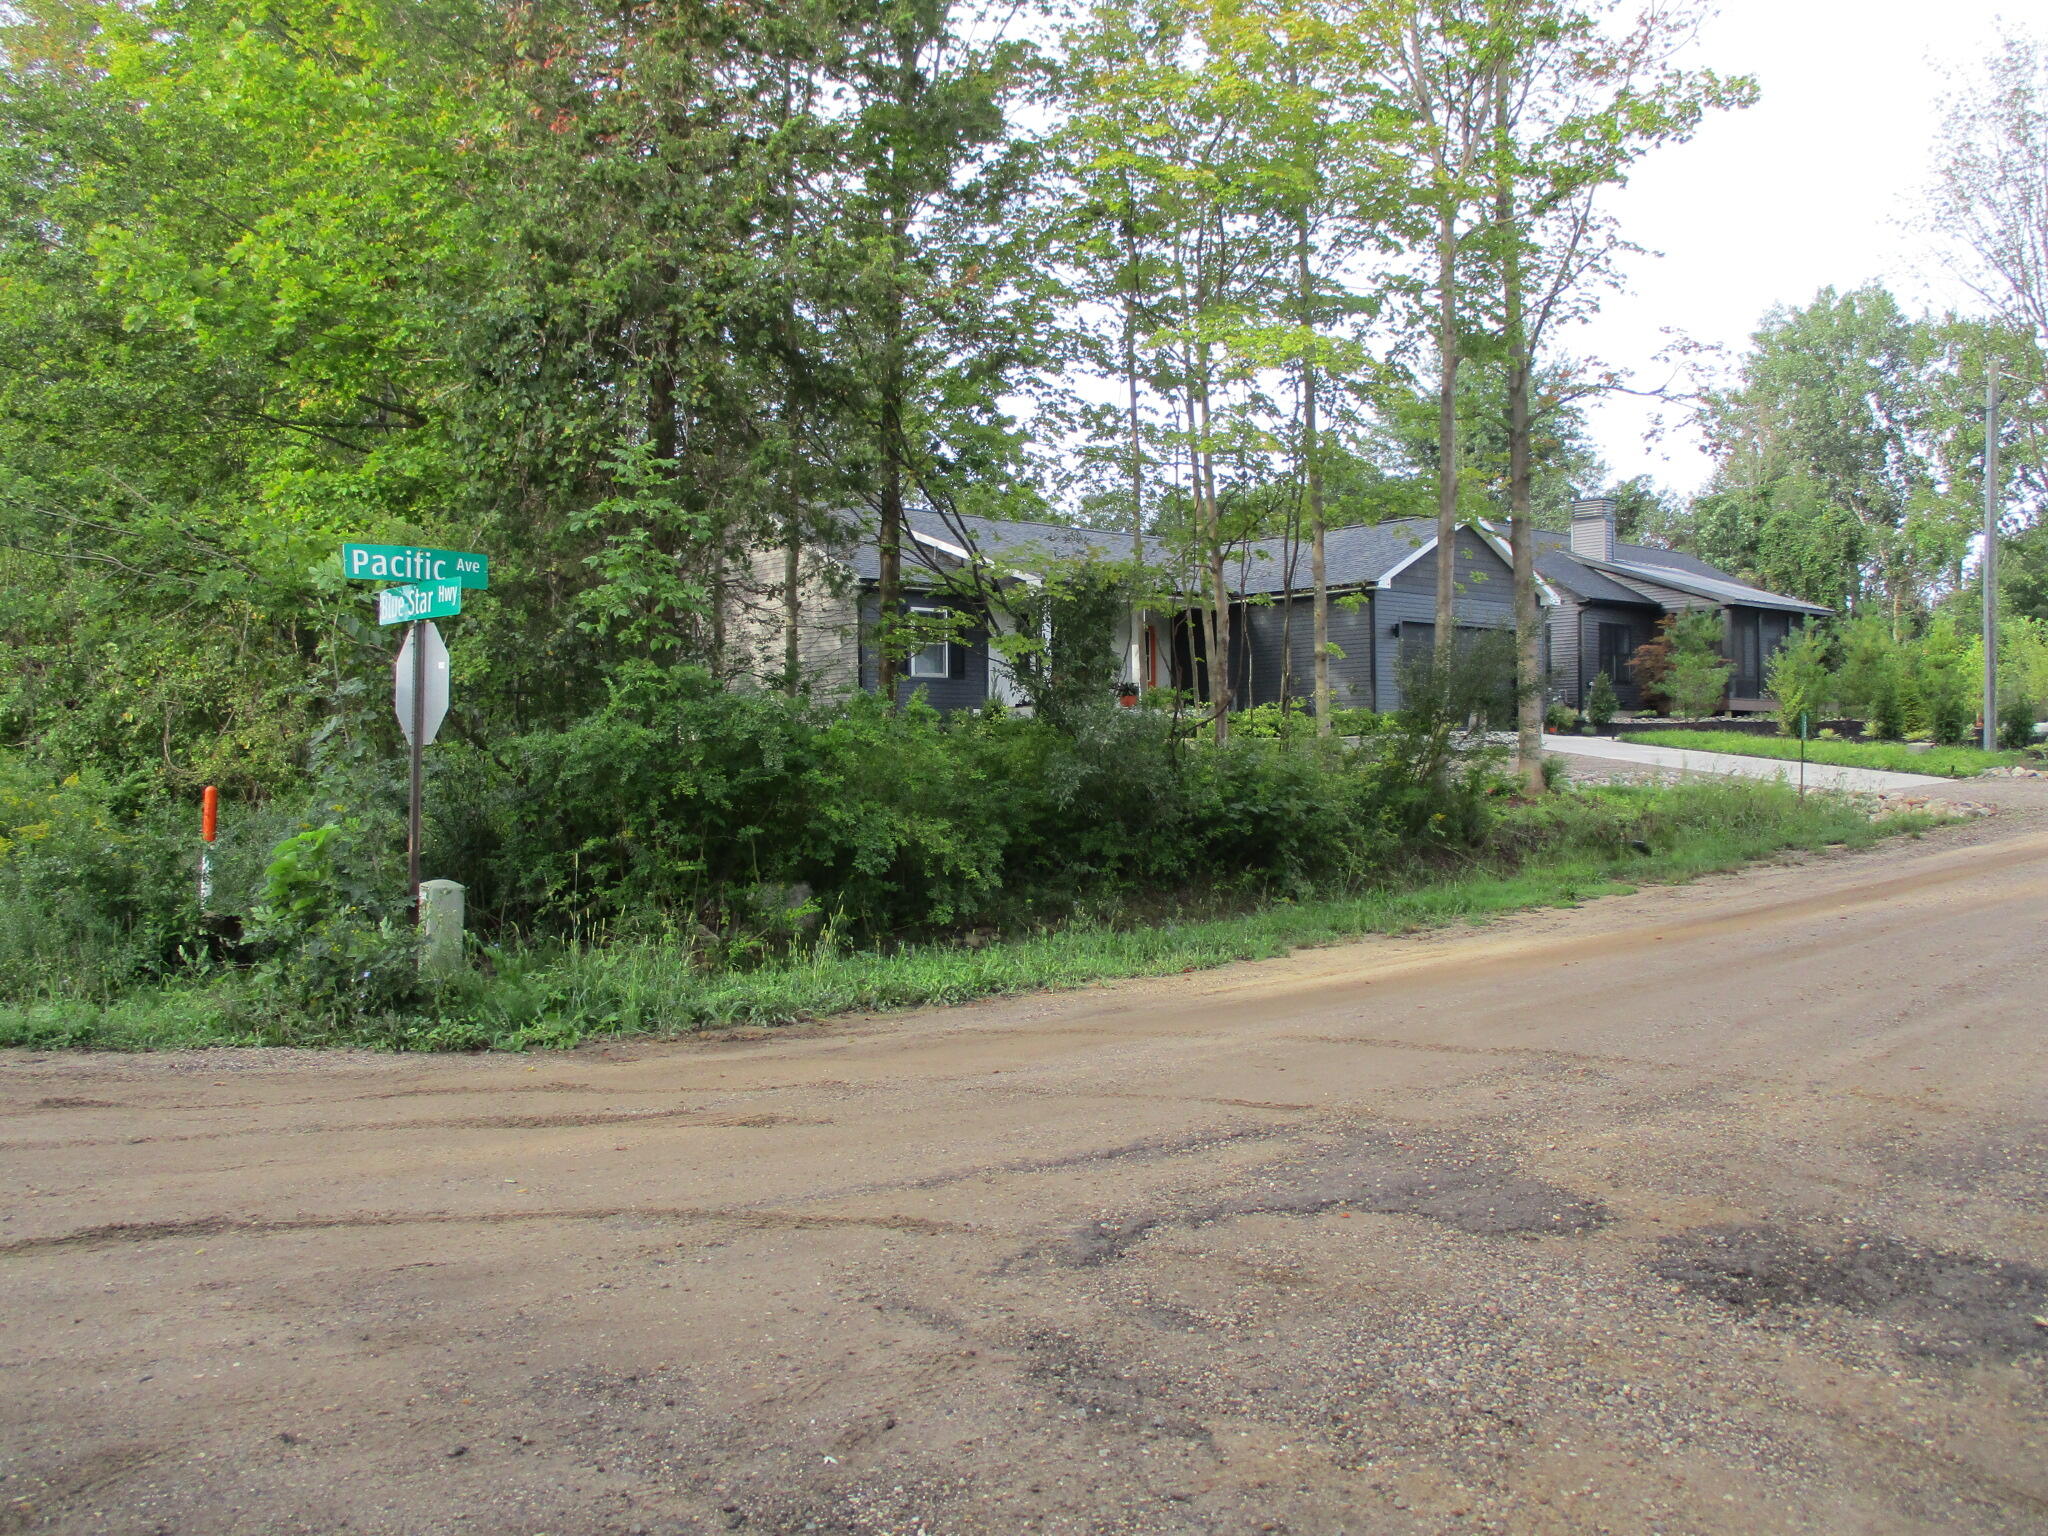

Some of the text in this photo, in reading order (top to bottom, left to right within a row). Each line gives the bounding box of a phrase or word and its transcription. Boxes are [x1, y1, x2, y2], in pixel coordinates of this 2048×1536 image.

[352, 549, 480, 580] Pacific Ave
[407, 590, 433, 616] Star
[438, 585, 458, 606] Hwy
